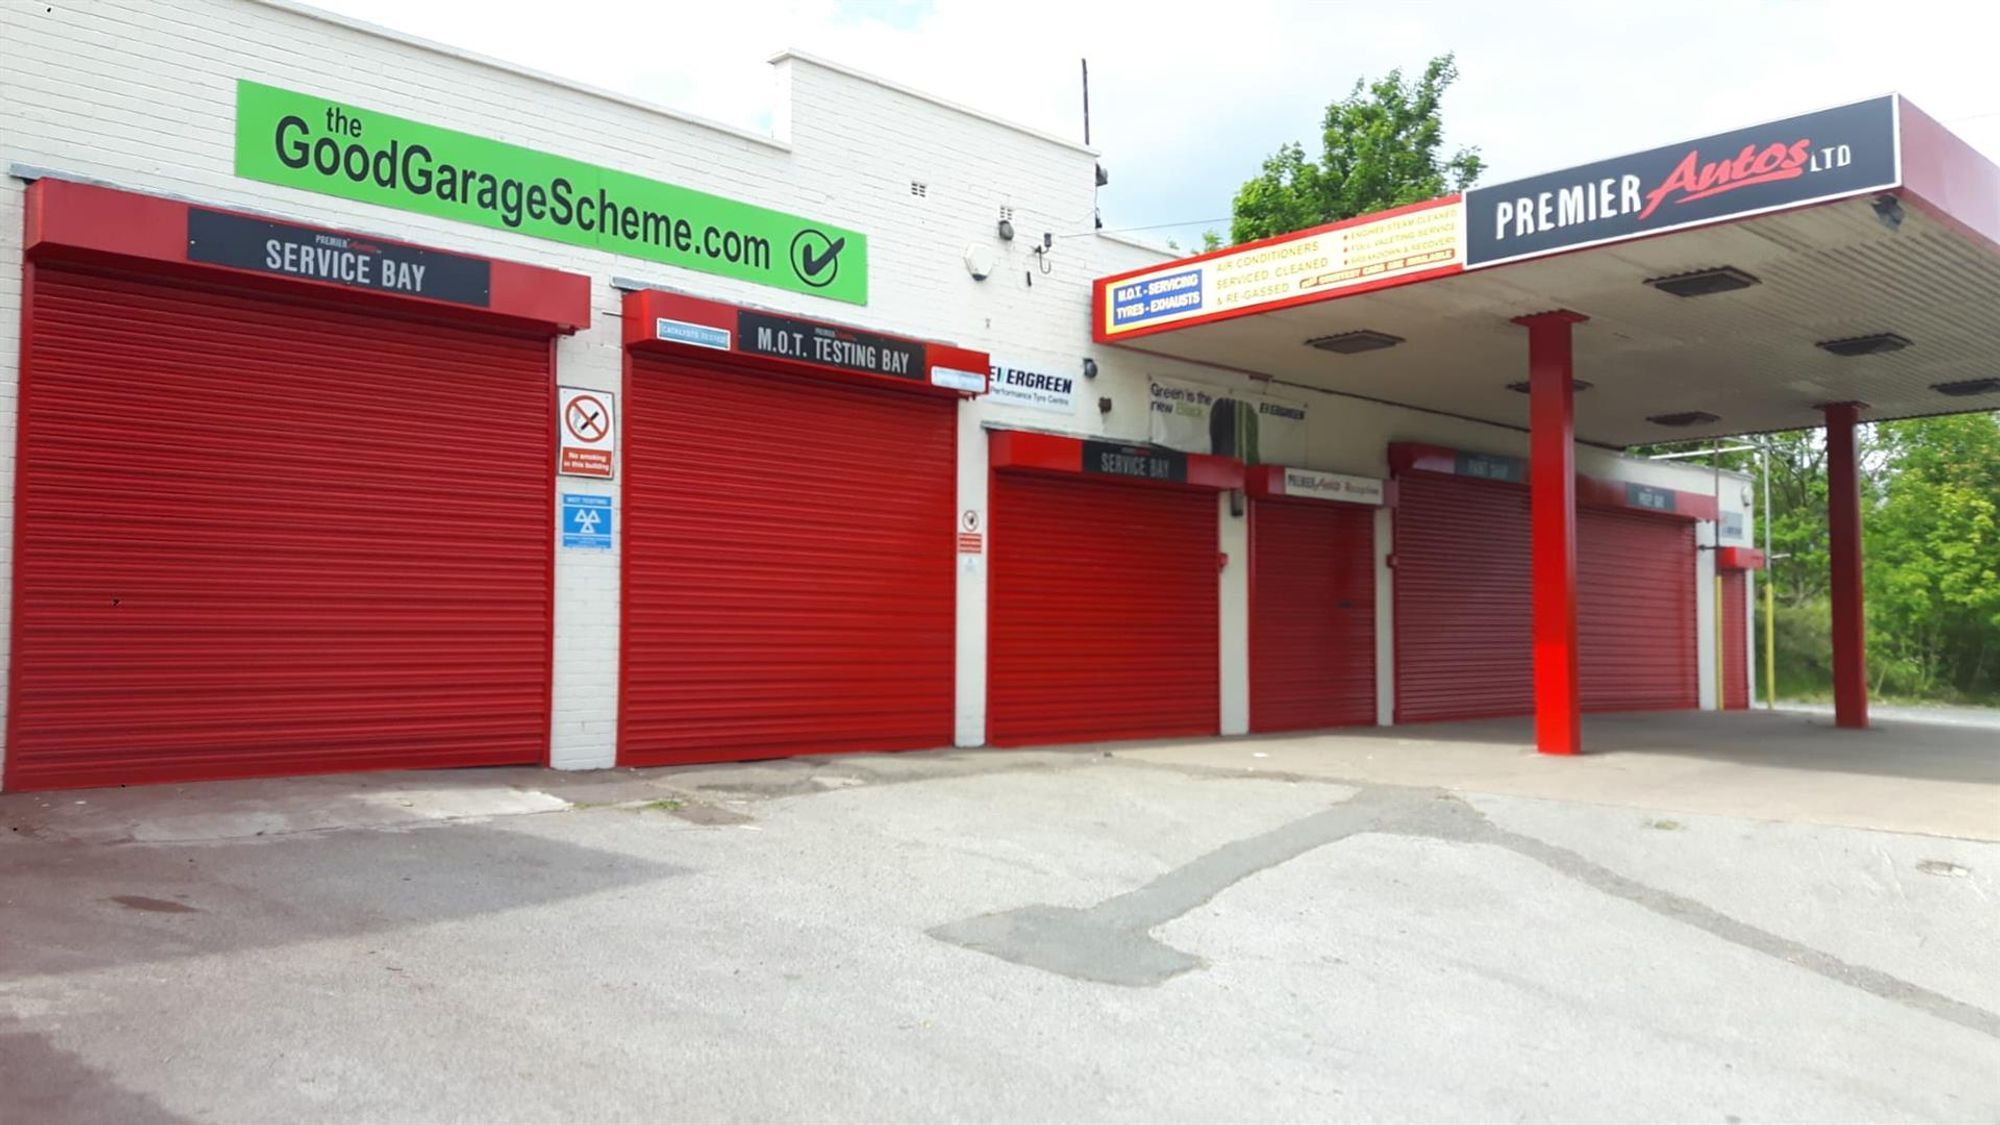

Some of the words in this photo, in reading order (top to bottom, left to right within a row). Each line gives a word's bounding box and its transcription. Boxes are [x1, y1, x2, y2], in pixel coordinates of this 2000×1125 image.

[326, 107, 362, 138] the
[275, 115, 770, 270] GoodGarageScheme.com
[1496, 173, 1642, 240] PREMIER
[1637, 138, 1811, 220] Autos
[1810, 144, 1852, 173] LTD
[265, 239, 371, 284] SERVICE
[381, 259, 425, 292] BAY
[1236, 241, 1319, 268] CONDITIONERS
[1216, 270, 1269, 290] SERVICED
[1275, 257, 1329, 278] CLEANED
[757, 326, 807, 358] M.O.T.
[814, 337, 876, 369] TESTING
[882, 349, 910, 374] BAY
[1151, 383, 1184, 401] Green
[1187, 391, 1195, 401] is
[1197, 391, 1212, 406] the
[1151, 401, 1174, 414] new
[1101, 452, 1147, 476] SERVICE
